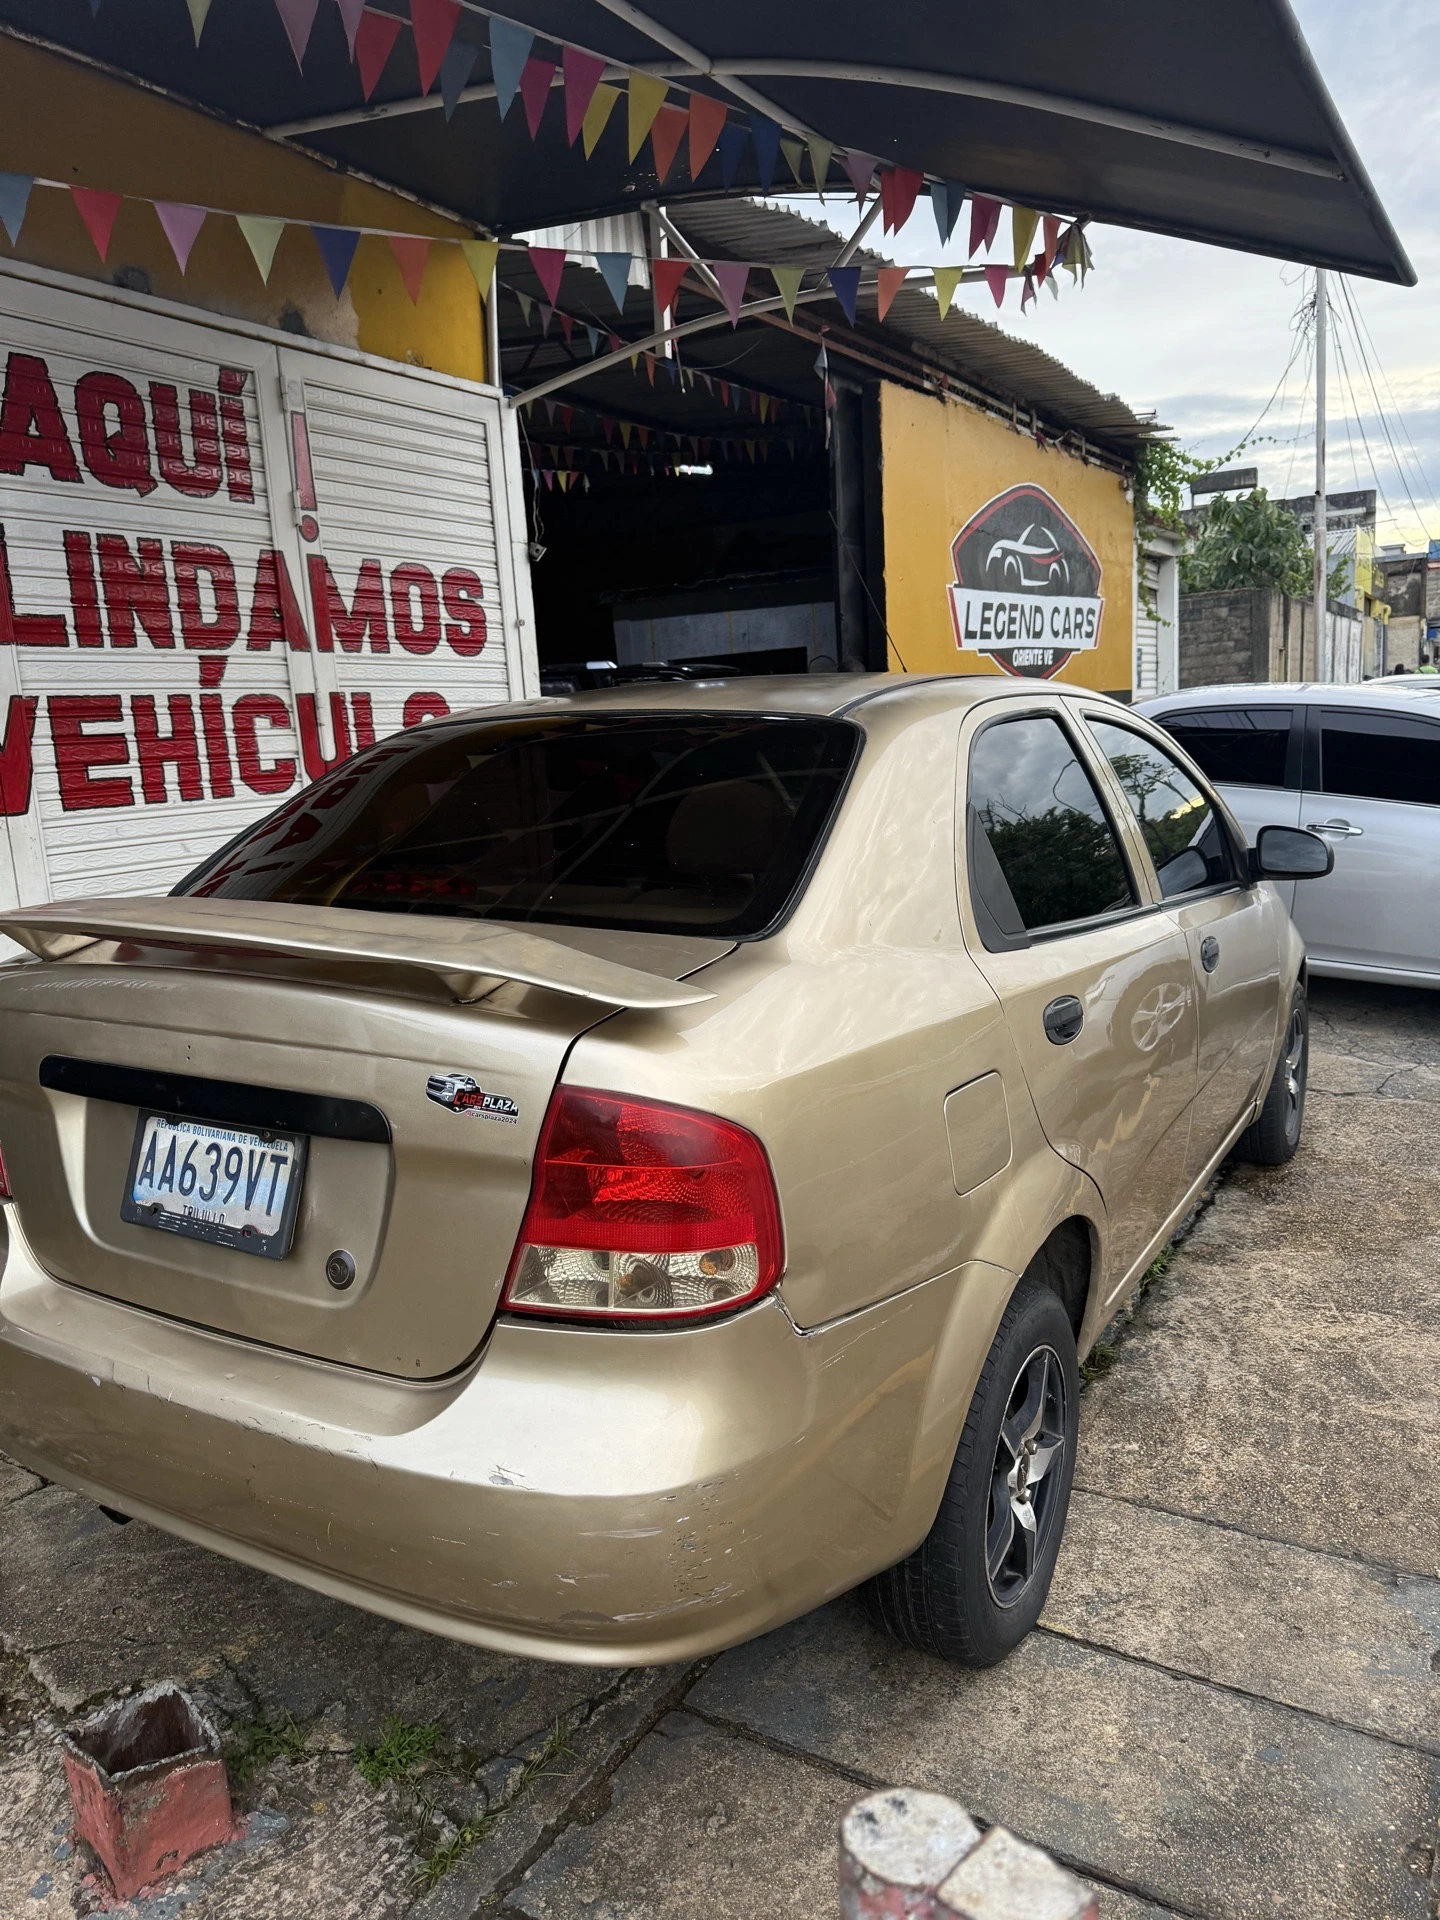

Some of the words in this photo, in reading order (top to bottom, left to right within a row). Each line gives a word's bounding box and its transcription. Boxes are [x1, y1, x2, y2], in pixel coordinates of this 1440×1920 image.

[964, 600, 1045, 641] LEGEND
[1050, 606, 1096, 640] CARS
[1012, 648, 1043, 667] ORIENTE
[1043, 648, 1054, 665] VE
[192, 1126, 236, 1143] BOLIVARIANA
[238, 1133, 248, 1145] DE
[138, 1129, 289, 1217] AA639VT
